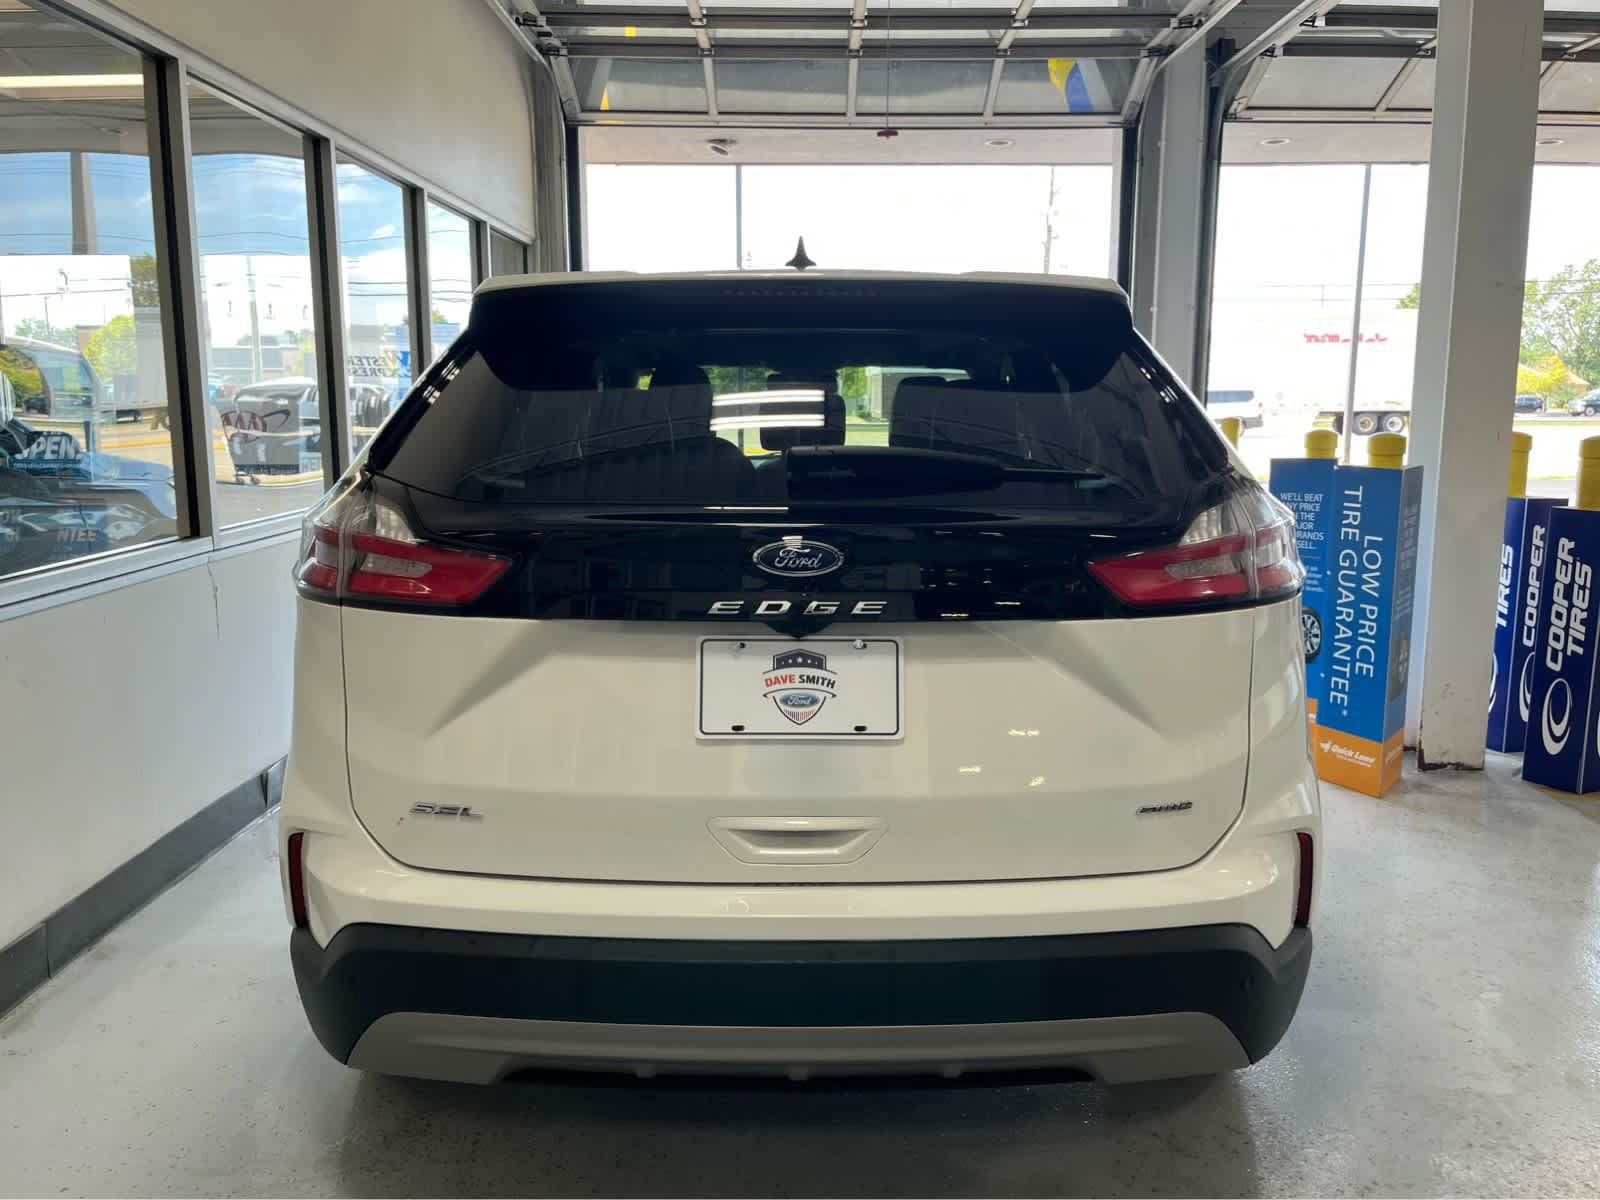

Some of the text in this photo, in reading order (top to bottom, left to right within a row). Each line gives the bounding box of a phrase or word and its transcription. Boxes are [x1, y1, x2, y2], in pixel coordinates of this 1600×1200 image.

[1303, 493, 1325, 502] BEAT
[1299, 503, 1320, 512] PRICE
[1300, 512, 1316, 521] THE
[1340, 485, 1363, 542] TIRE
[774, 547, 823, 569] Ford
[1495, 543, 1514, 628] TIRES
[1522, 524, 1546, 649] COOPER
[707, 600, 888, 615] EDGE
[1354, 535, 1384, 678] LOW PRICE
[1545, 536, 1576, 673] COOPER
[1566, 561, 1593, 657] TIRES
[764, 673, 836, 689] DAVE SMITH
[787, 694, 812, 705] Ford
[409, 801, 484, 818] SEL
